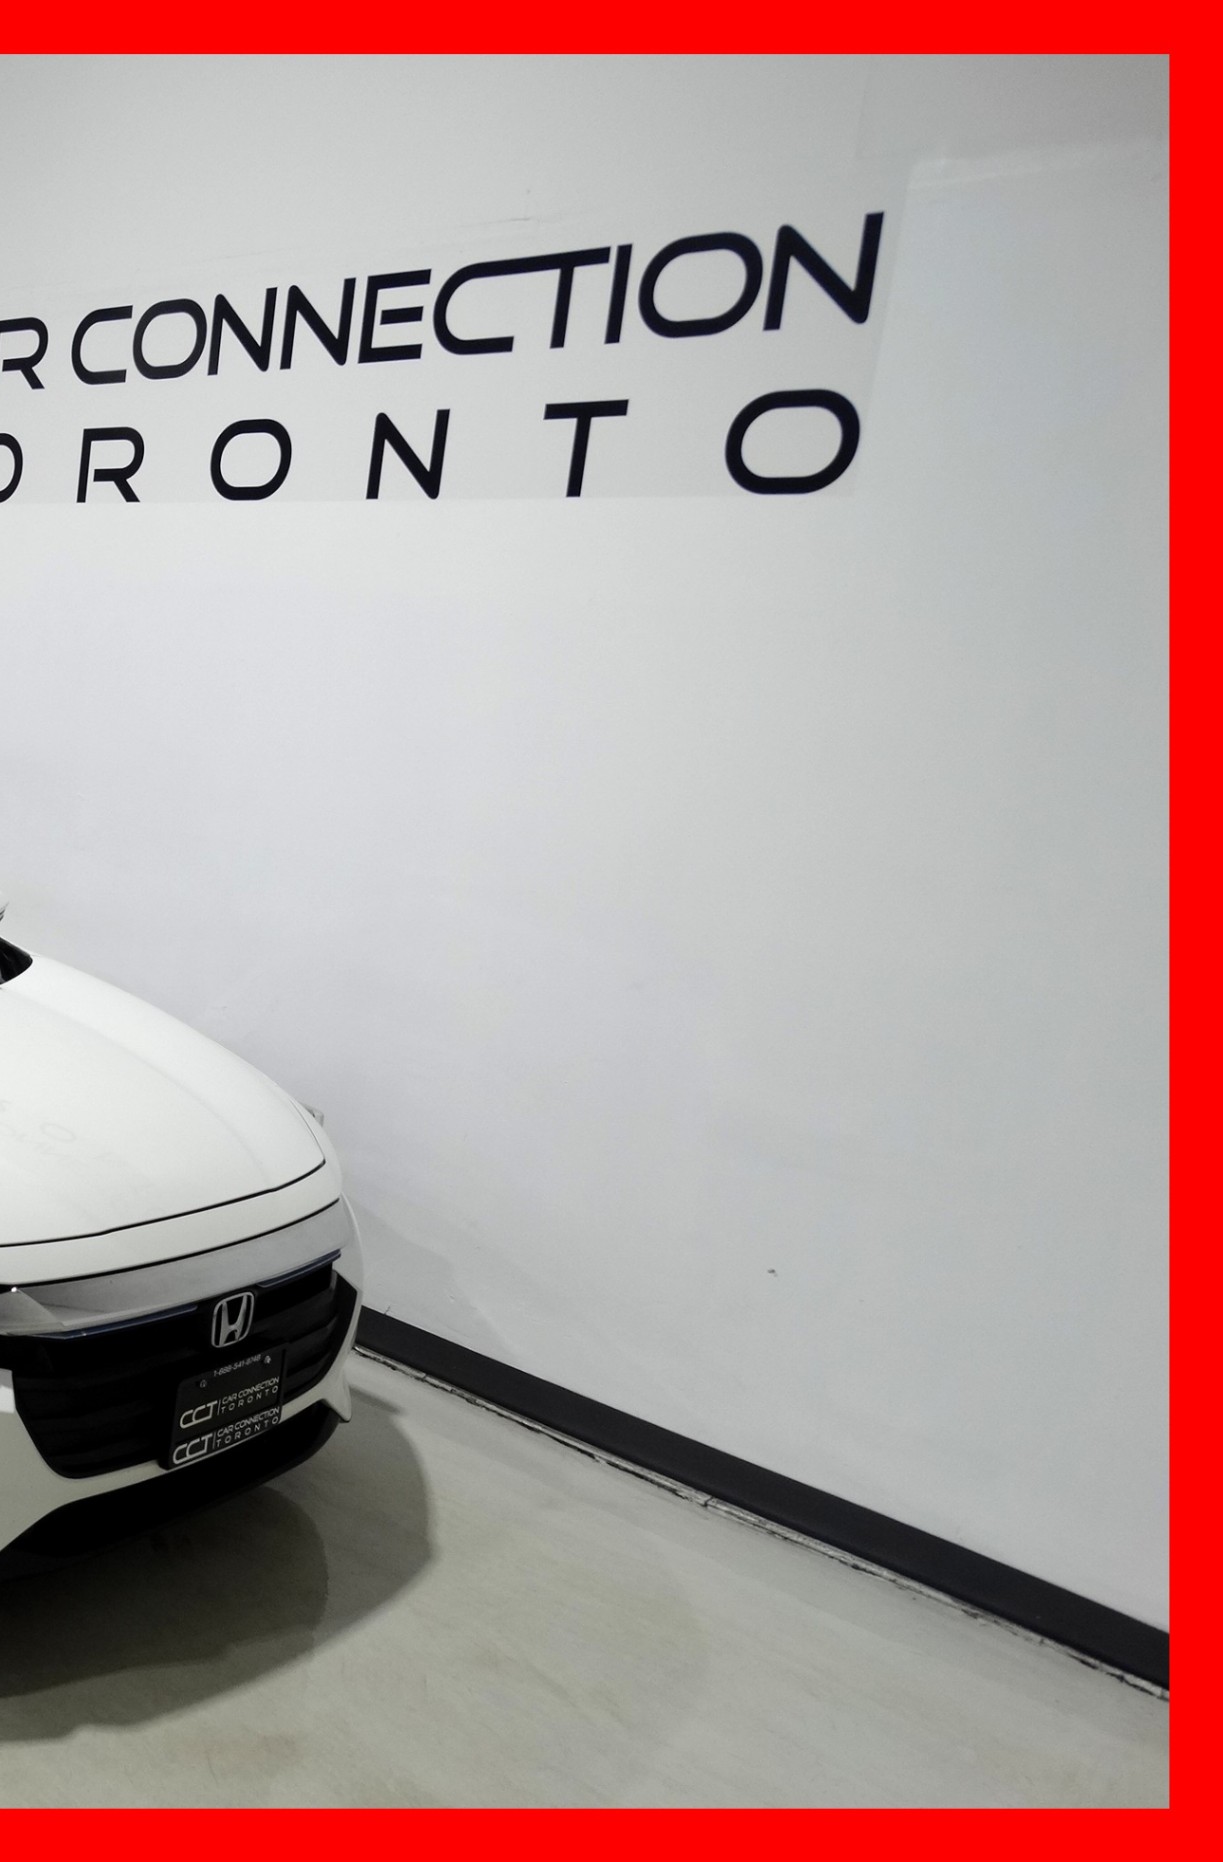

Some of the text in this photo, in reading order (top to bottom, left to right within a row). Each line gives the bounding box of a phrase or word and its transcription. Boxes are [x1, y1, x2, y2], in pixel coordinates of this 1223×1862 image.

[71, 211, 885, 385] CONNECTION
[221, 1385, 279, 1414] TORONTO
[222, 1376, 280, 1405] CAR CONNECTION
[179, 1399, 218, 1429] CCT
[217, 1406, 280, 1438] CAR CONNECTION
[216, 1416, 279, 1448] TORONTO
[172, 1432, 213, 1465] CCT
